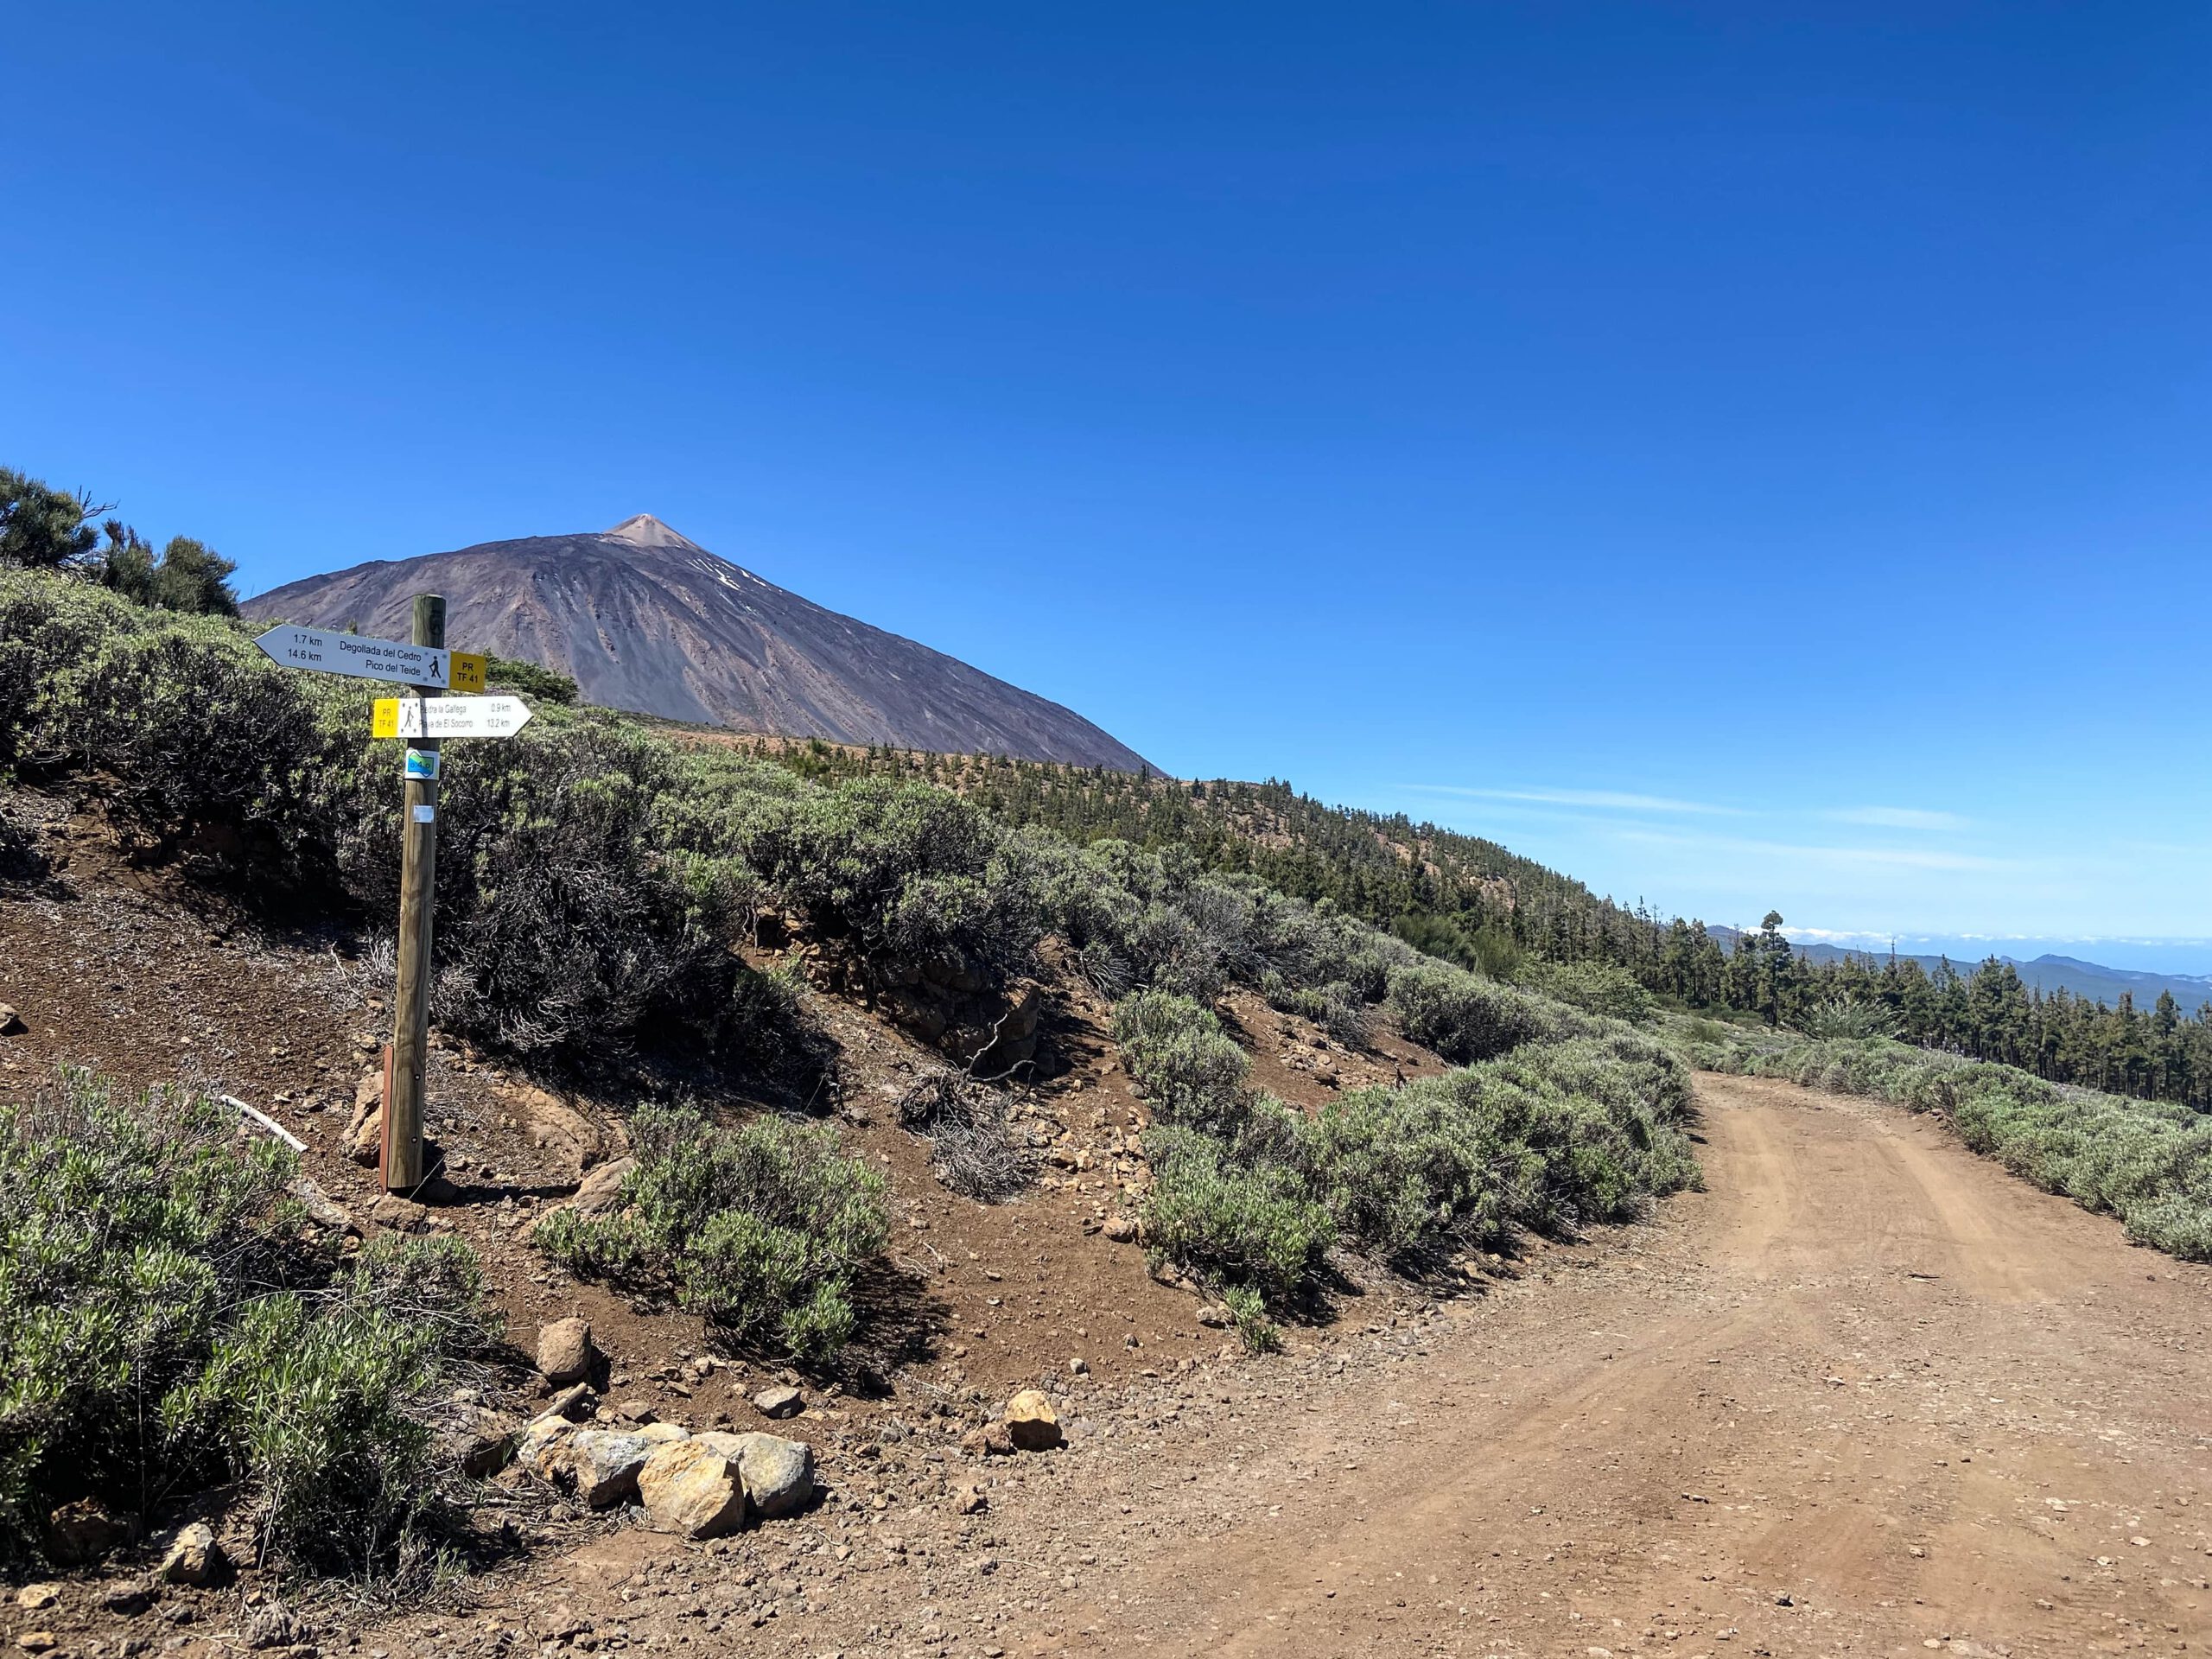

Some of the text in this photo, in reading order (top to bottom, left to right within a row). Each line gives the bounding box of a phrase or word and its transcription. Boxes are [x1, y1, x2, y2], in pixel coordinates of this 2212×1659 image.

[294, 634, 322, 646] 1.7 km
[288, 648, 321, 662] 14.6 km
[340, 640, 422, 662] Degollada del Cedro
[365, 659, 421, 676] Pico del Teide
[462, 662, 474, 671] PR
[457, 672, 467, 681] TF
[383, 708, 391, 716] PR
[491, 703, 512, 713] 0.9 km
[378, 720, 386, 728] TF
[443, 719, 451, 728] El
[451, 719, 474, 728] Socorro
[487, 719, 511, 728] 13.2 km
